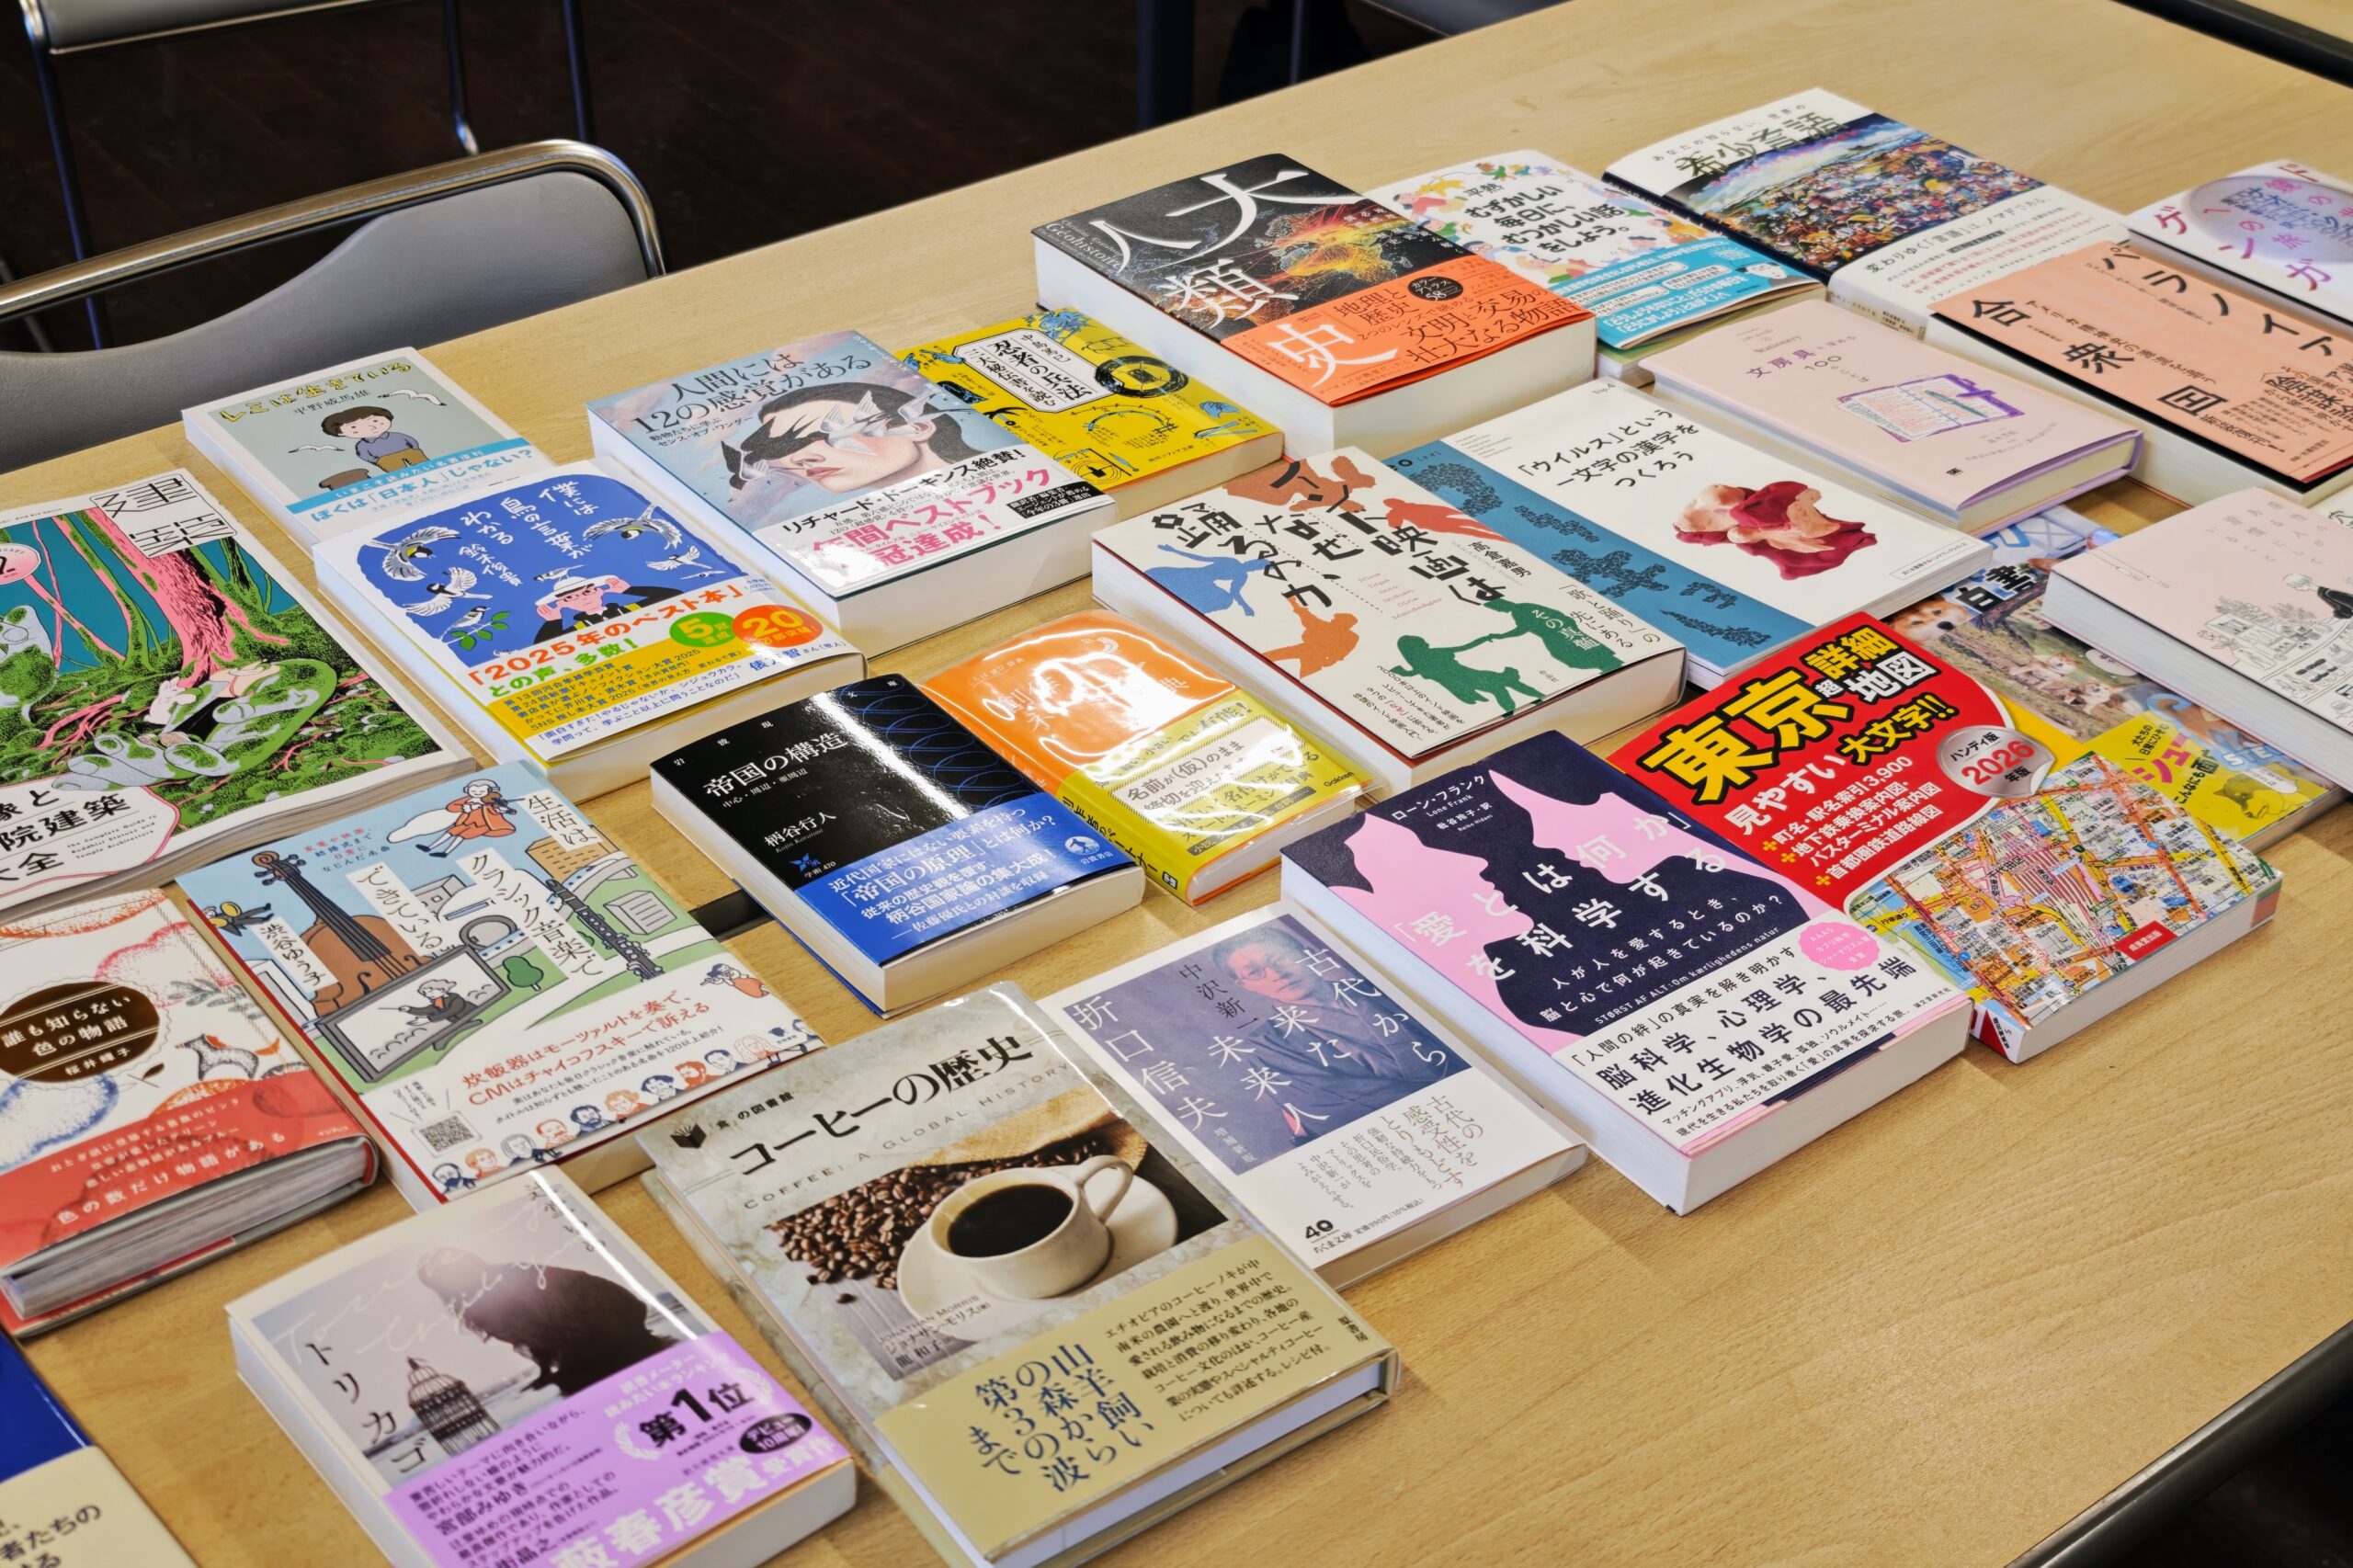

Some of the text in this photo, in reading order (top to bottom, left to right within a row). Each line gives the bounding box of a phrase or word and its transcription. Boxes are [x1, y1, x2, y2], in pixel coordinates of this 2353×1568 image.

[1675, 111, 1849, 177] 希少言語
[1142, 164, 1359, 275] 大
[1463, 183, 1504, 198] 平熱
[1464, 186, 1565, 219] むずかしい
[1494, 203, 1576, 229] 毎日に、
[1500, 203, 1626, 244] むつかしい話
[1537, 226, 1631, 253] をしよう。
[1333, 288, 1407, 318] 地理と
[1356, 295, 1473, 343] 2つのレンズで眺める
[1359, 302, 1421, 327] 歴史
[1400, 286, 1549, 347] 文明と交易の
[1405, 299, 1582, 365] 壮大なる物語
[2102, 237, 2334, 358] パラノイア
[670, 354, 805, 403] 人間には
[965, 348, 1057, 408] 三大秘伝書を読む
[987, 340, 1094, 402] 忍者の兵法
[1021, 335, 1072, 364] 中島篤己
[1801, 354, 1845, 371] 100
[1972, 297, 2230, 418] 合衆国
[220, 361, 412, 424] レミは生きている
[631, 355, 872, 434] 12の感覚がある
[650, 416, 723, 441] 動物たちに学ぶ
[656, 416, 756, 449] センス・オブ・ワンダー
[1510, 408, 1687, 477] 「ウイルス」という
[1541, 422, 1711, 489] 一文字の漢字を
[311, 448, 534, 523] ぼくは「日本人」じゃない?
[539, 480, 600, 517] 僕には
[782, 448, 1028, 534] リチャード・ドーキンス絶賛!
[1605, 449, 1701, 490] つくろう
[460, 511, 515, 546] わかる
[500, 496, 594, 560] 鳥の言葉が
[1466, 539, 1534, 579] 高倉嘉男
[459, 543, 525, 587] 鈴木俊貴
[1955, 564, 2038, 614] 白書
[468, 584, 745, 687] 「2025年のベスト本」
[742, 609, 804, 639] 20
[1526, 606, 1602, 651] その真髄
[1558, 583, 1661, 645] 「歌と踊り」の
[1570, 611, 1634, 649] 先にある
[488, 637, 640, 699] との声、多数!
[1838, 648, 1940, 705] 地図
[1622, 626, 1901, 808] 東京 超 詳細
[1946, 731, 2003, 762] ハンディ版
[2131, 724, 2154, 747] 犬たちの
[698, 729, 851, 800] 帝国の構造
[720, 767, 810, 808] 中心・周辺・亜周辺
[1122, 734, 1247, 807] 名前が(仮)のまま
[1386, 773, 1491, 821] ローン・フランク
[1712, 691, 1961, 836] 見やすい 大文字!!
[1958, 739, 2040, 786] 2026
[2002, 766, 2033, 784] 年版
[527, 793, 598, 846] 生活は
[761, 809, 837, 847] 柄谷行人
[1423, 793, 1476, 817] Lone Frank
[1434, 801, 1495, 830] 枇谷玲子・訳
[1761, 755, 1927, 845] 町名・駅名索引3,900
[1780, 777, 1926, 858] 地下鉄乗換案内図・
[1795, 780, 1952, 867] バスターミナル案内図
[825, 807, 1029, 893] 近代国家にはない要素を持つ
[837, 812, 1064, 907] 「帝国の原理」とは何か?
[1815, 803, 1954, 881] 首都圏鉄道路線図
[357, 865, 443, 949] できている
[472, 853, 603, 977] クラシック音楽で
[881, 847, 1063, 926] 柄谷国家論の集大成!
[909, 870, 1055, 933] 佐藤優氏との対談を収録
[1391, 807, 1694, 953] 「愛とは何か」
[1456, 843, 1740, 985] を科学する
[256, 919, 332, 989] 渋谷ゆう子
[1535, 893, 1790, 1023] 脳と心で何が起きているのか?
[1544, 891, 1743, 991] 人が人を愛するとき、
[1593, 926, 1785, 1025] STØRST AF kærlighedens natur
[2, 991, 134, 1050] 誰も知らない
[1172, 960, 1261, 1029] 中沢新一
[1288, 942, 1461, 1073] 古代から
[1567, 945, 1803, 1069] 「人間の絆」の真実を解き明かす
[1594, 962, 1832, 1092] 脳科学、心理学、
[31, 1012, 130, 1060] 色の物語
[456, 987, 697, 1090] 炊飯器はモーツァルトを奏で、
[462, 999, 716, 1108] CMはチャイコフスキーで訴える
[1065, 992, 1231, 1134] 折口信夫
[1259, 998, 1359, 1069] 来た
[1626, 954, 1919, 1117] 進化生物学の最先端
[724, 1028, 1038, 1181] コーヒーの歴史
[878, 1107, 971, 1152] GLOBAL
[975, 1061, 1074, 1108] HISTORY
[1195, 1028, 1333, 1137] 未来人
[1674, 1005, 1914, 1139] 現代を生きる私たちを取り巻く「愛」の真実を探求する旅。
[1375, 1110, 1474, 1190] とりもどす
[1396, 1101, 1486, 1172] 感受性を
[1421, 1091, 1491, 1142] 古代の
[55, 1125, 290, 1229] 色の数だけ物語がある
[1307, 1152, 1353, 1190] 中沢新一が
[1336, 1138, 1384, 1177] その思考の
[1311, 1229, 1356, 1256] ちくま文庫
[1098, 1257, 1267, 1340] エチオピアのコーヒーノキが中
[1110, 1270, 1279, 1354] 南米の農園へと渡り、世界中で
[1123, 1280, 1299, 1369] 愛される飲み物になるまでの歴史。
[1135, 1296, 1305, 1381] 栽培と消費の移り変わり、各地の
[1147, 1309, 1318, 1395] コーヒー文化のほか、コーヒー産
[1160, 1323, 1332, 1410] 業の実態やスペシャルティコーヒー
[301, 1328, 439, 1478] トリカゴ
[623, 1368, 763, 1449] 第1位
[1006, 1353, 1131, 1474] の森から
[1041, 1335, 1165, 1453] 山羊飼い
[1173, 1340, 1338, 1424] についても詳述する。レシピ付。
[954, 1415, 1031, 1486] まで
[967, 1370, 1094, 1496] 第3の波
[428, 1479, 537, 1539] 宮部みゆき
